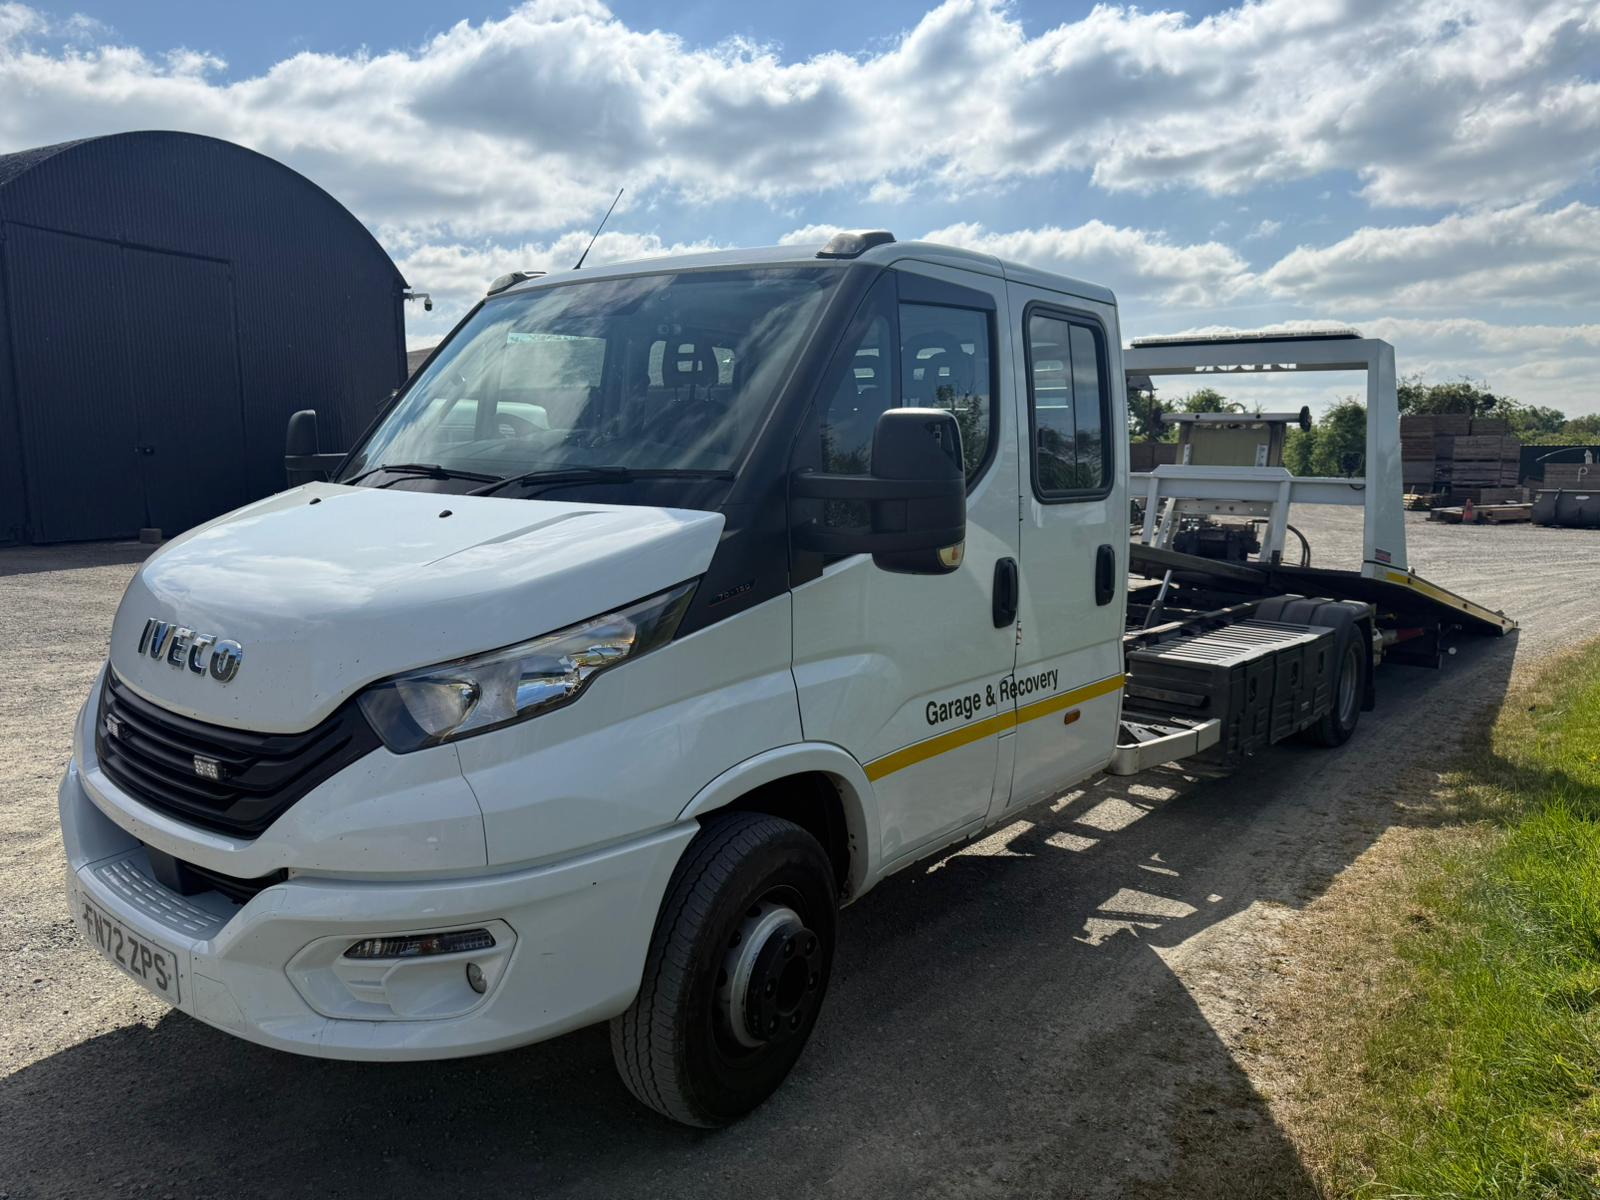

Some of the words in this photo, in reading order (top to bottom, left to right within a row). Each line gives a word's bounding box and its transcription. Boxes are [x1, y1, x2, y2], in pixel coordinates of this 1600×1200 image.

[138, 617, 242, 683] IVECO
[925, 692, 981, 725] Garage
[985, 684, 996, 707] &
[1000, 669, 1058, 702] Recovery
[83, 902, 127, 966] FN72
[127, 935, 168, 991] ZPS
